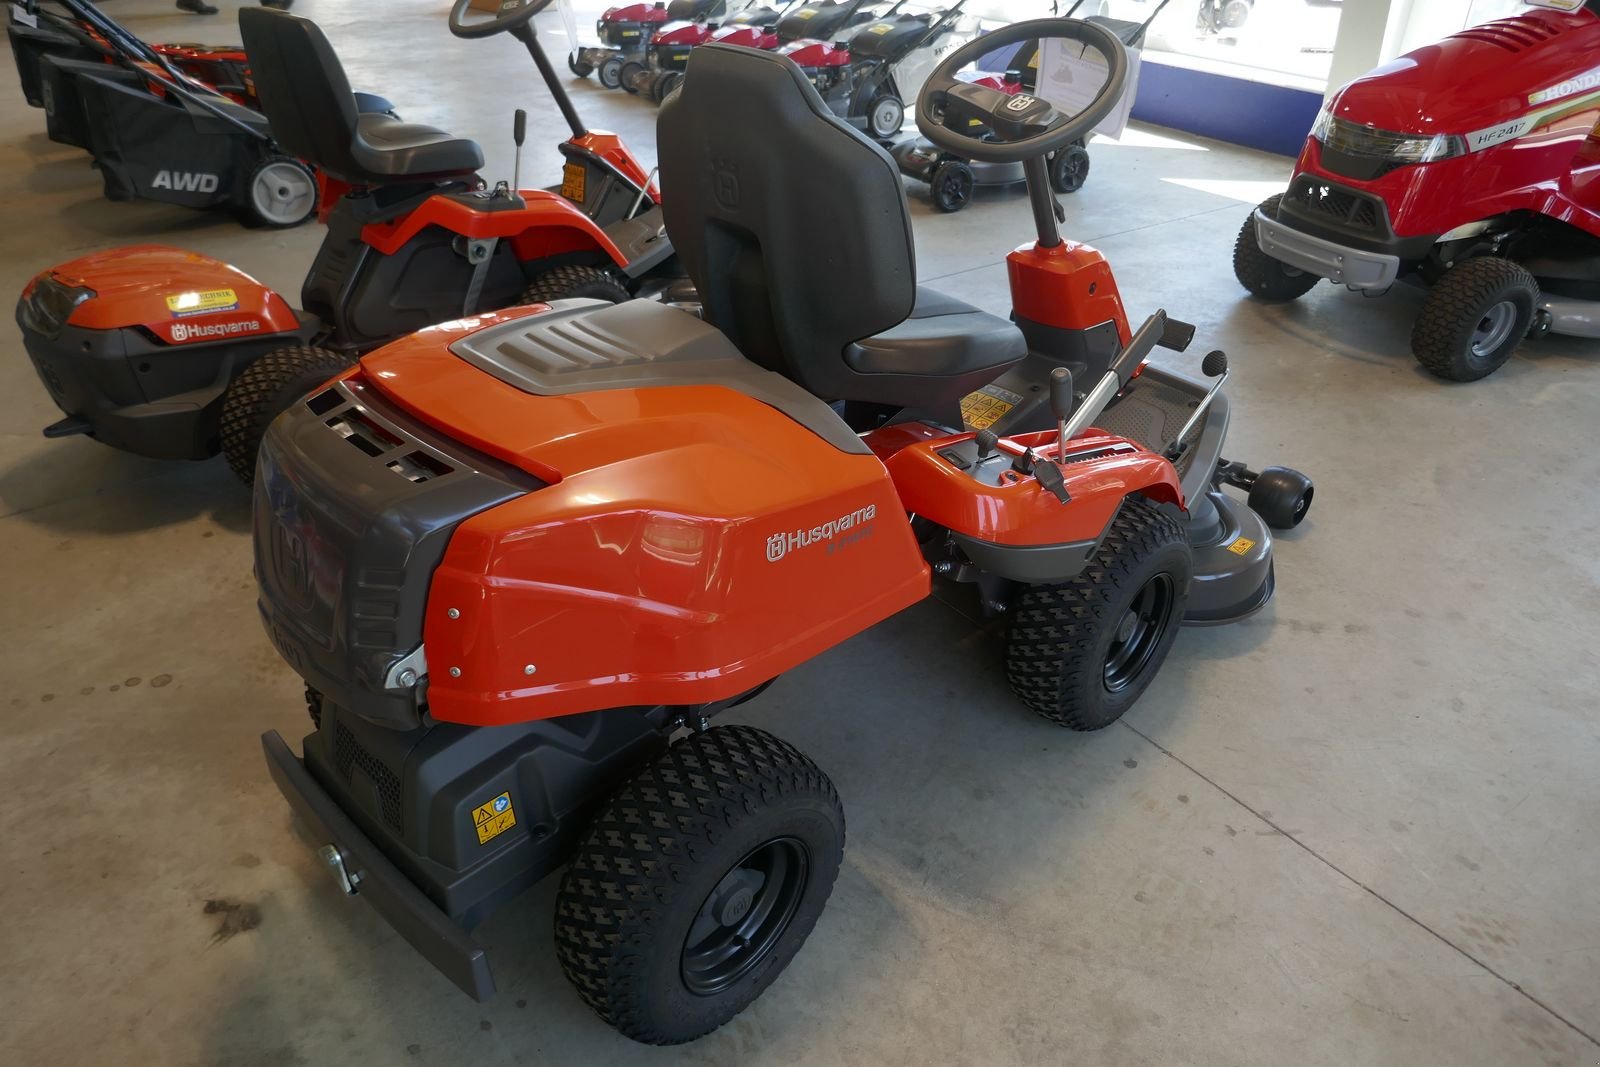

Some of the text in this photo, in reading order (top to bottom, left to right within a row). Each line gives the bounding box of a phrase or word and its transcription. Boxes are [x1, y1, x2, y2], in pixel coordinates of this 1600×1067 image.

[1478, 122, 1526, 145] HF 2417
[152, 170, 219, 193] AWD
[187, 320, 261, 337] Husqvarna
[788, 503, 877, 553] Husqvarna
